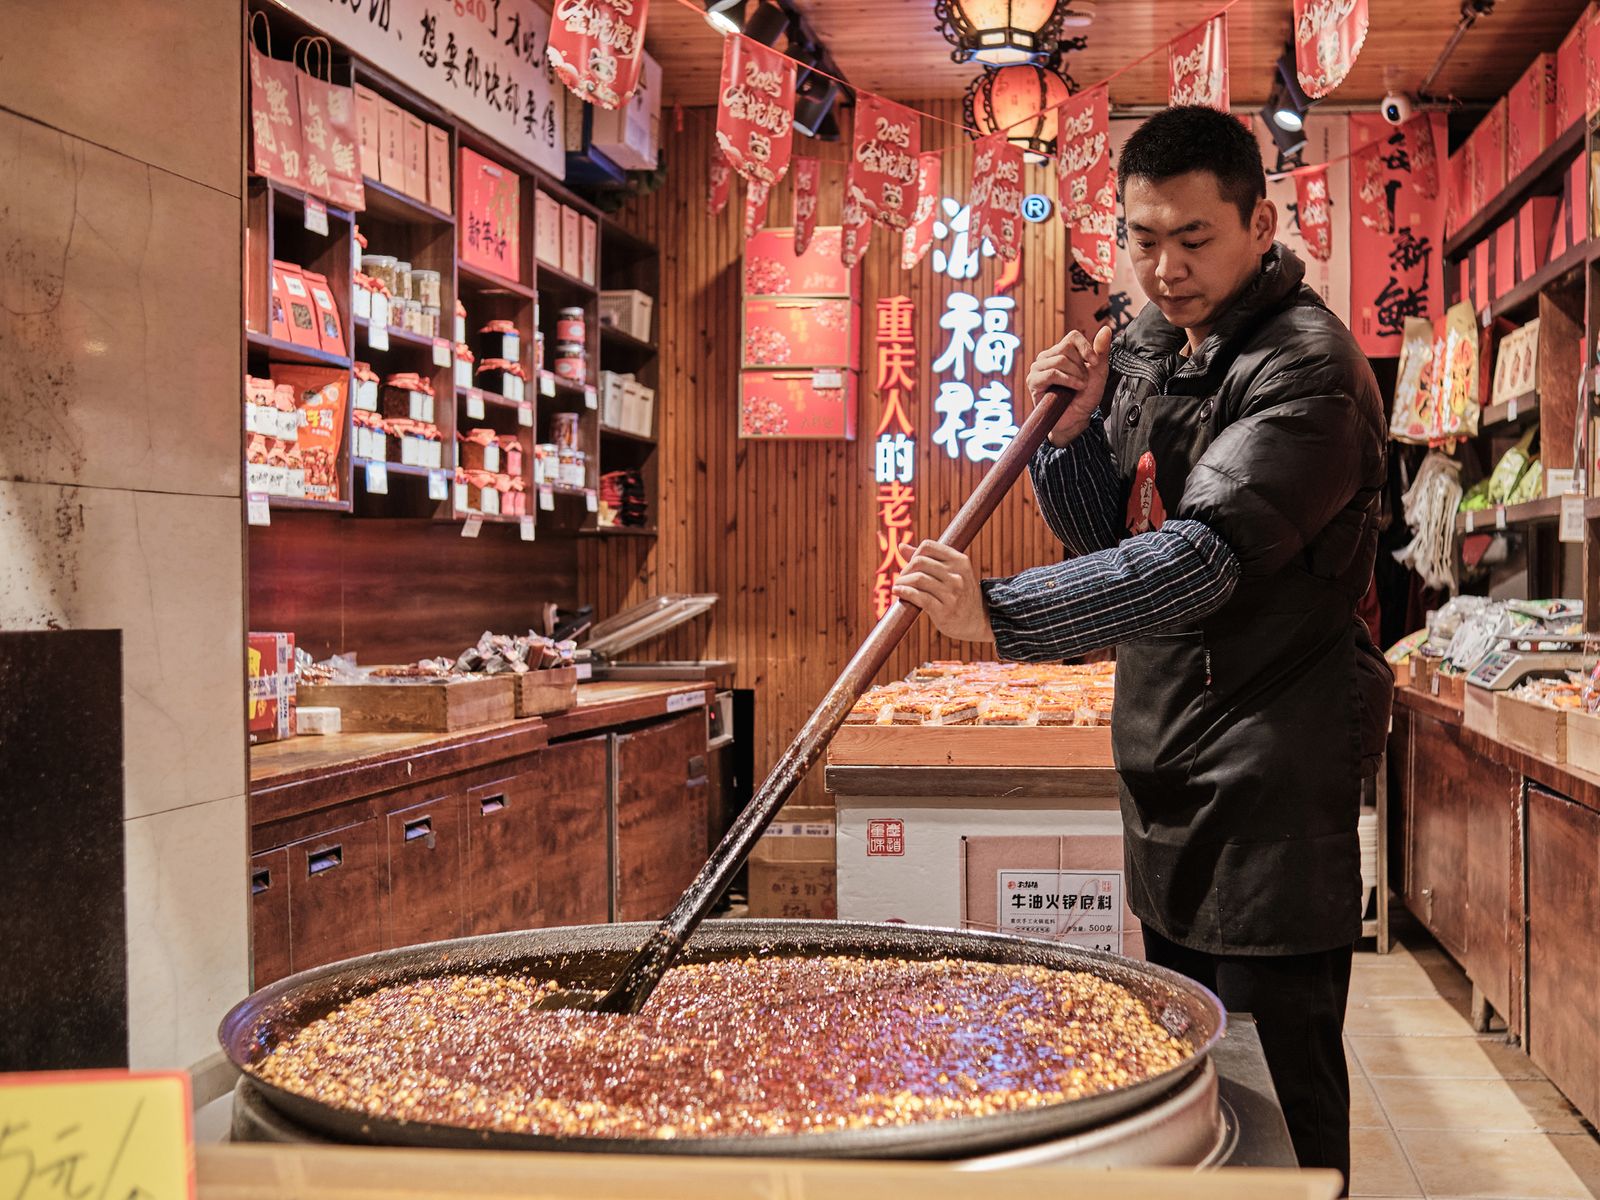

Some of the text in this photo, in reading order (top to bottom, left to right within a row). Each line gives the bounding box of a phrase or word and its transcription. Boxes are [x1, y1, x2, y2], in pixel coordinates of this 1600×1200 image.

[745, 61, 783, 98] 2025
[874, 116, 911, 148] 2025
[1064, 104, 1095, 142] 2025
[1374, 127, 1433, 338] 每新鲜
[1011, 894, 1112, 910] 牛油火锅底料
